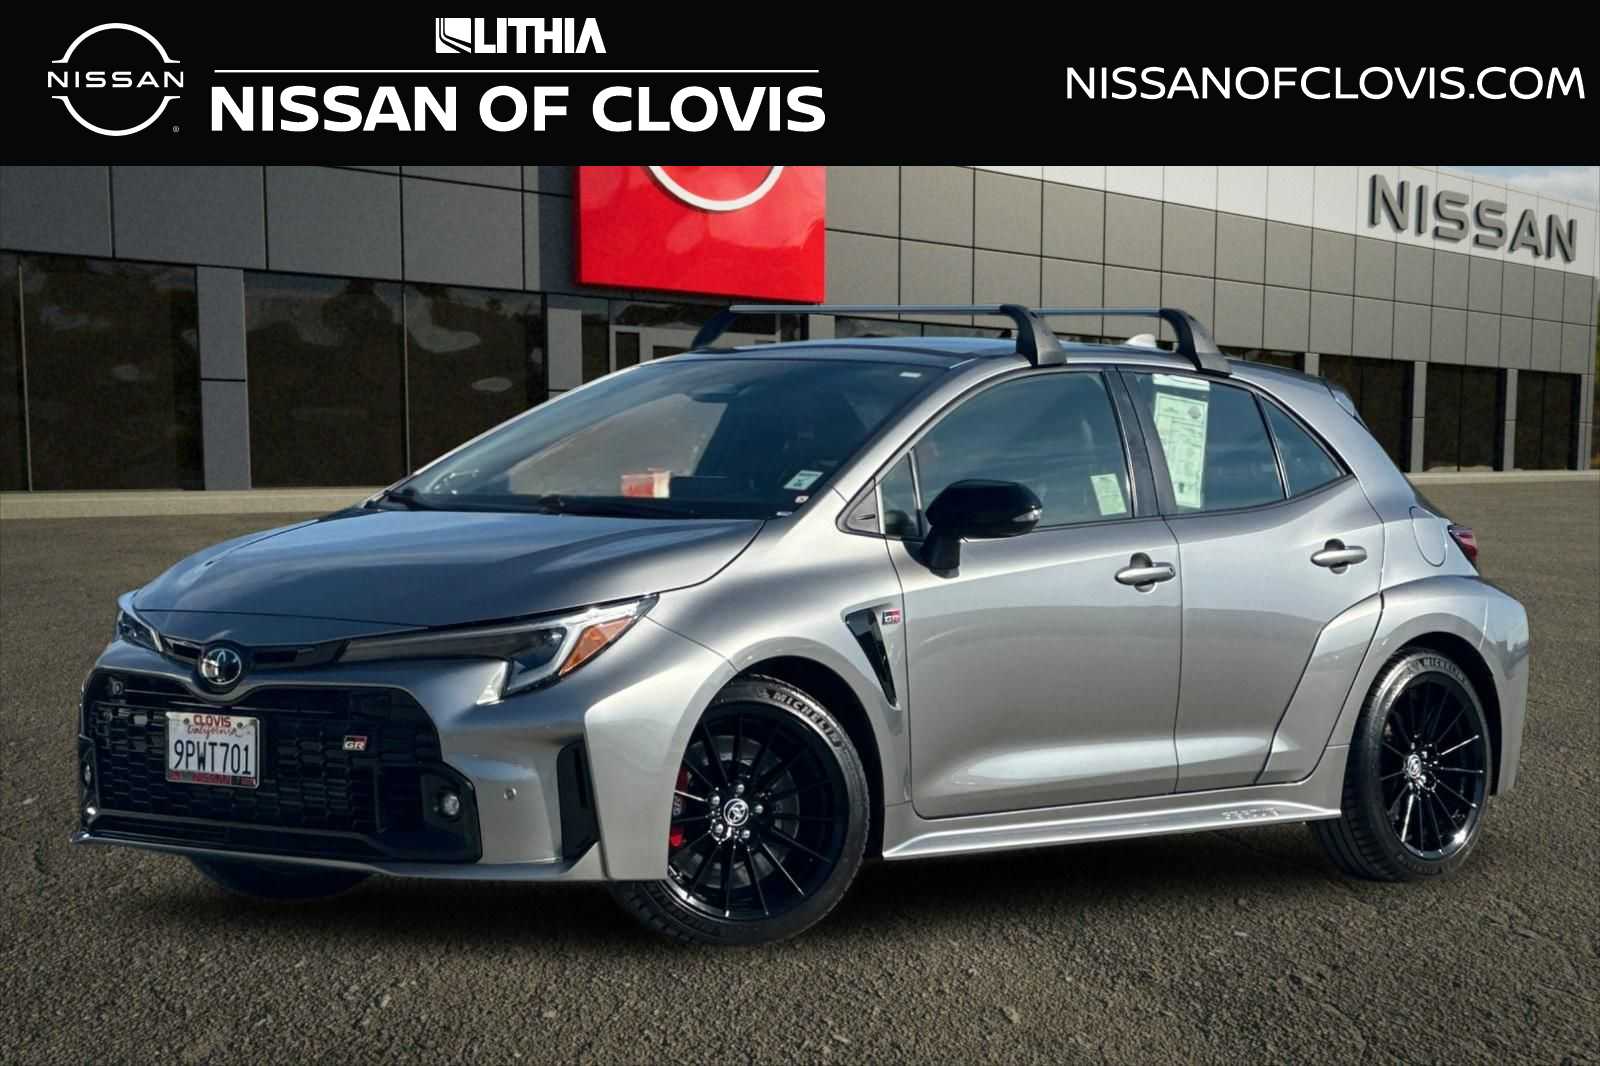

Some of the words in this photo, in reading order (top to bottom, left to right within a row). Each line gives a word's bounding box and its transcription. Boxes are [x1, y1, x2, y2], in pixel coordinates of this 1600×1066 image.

[1368, 174, 1577, 263] NISSAN
[193, 714, 231, 728] CLOVIS
[772, 691, 842, 746] MICHELIN
[174, 739, 251, 775] 9PWT701
